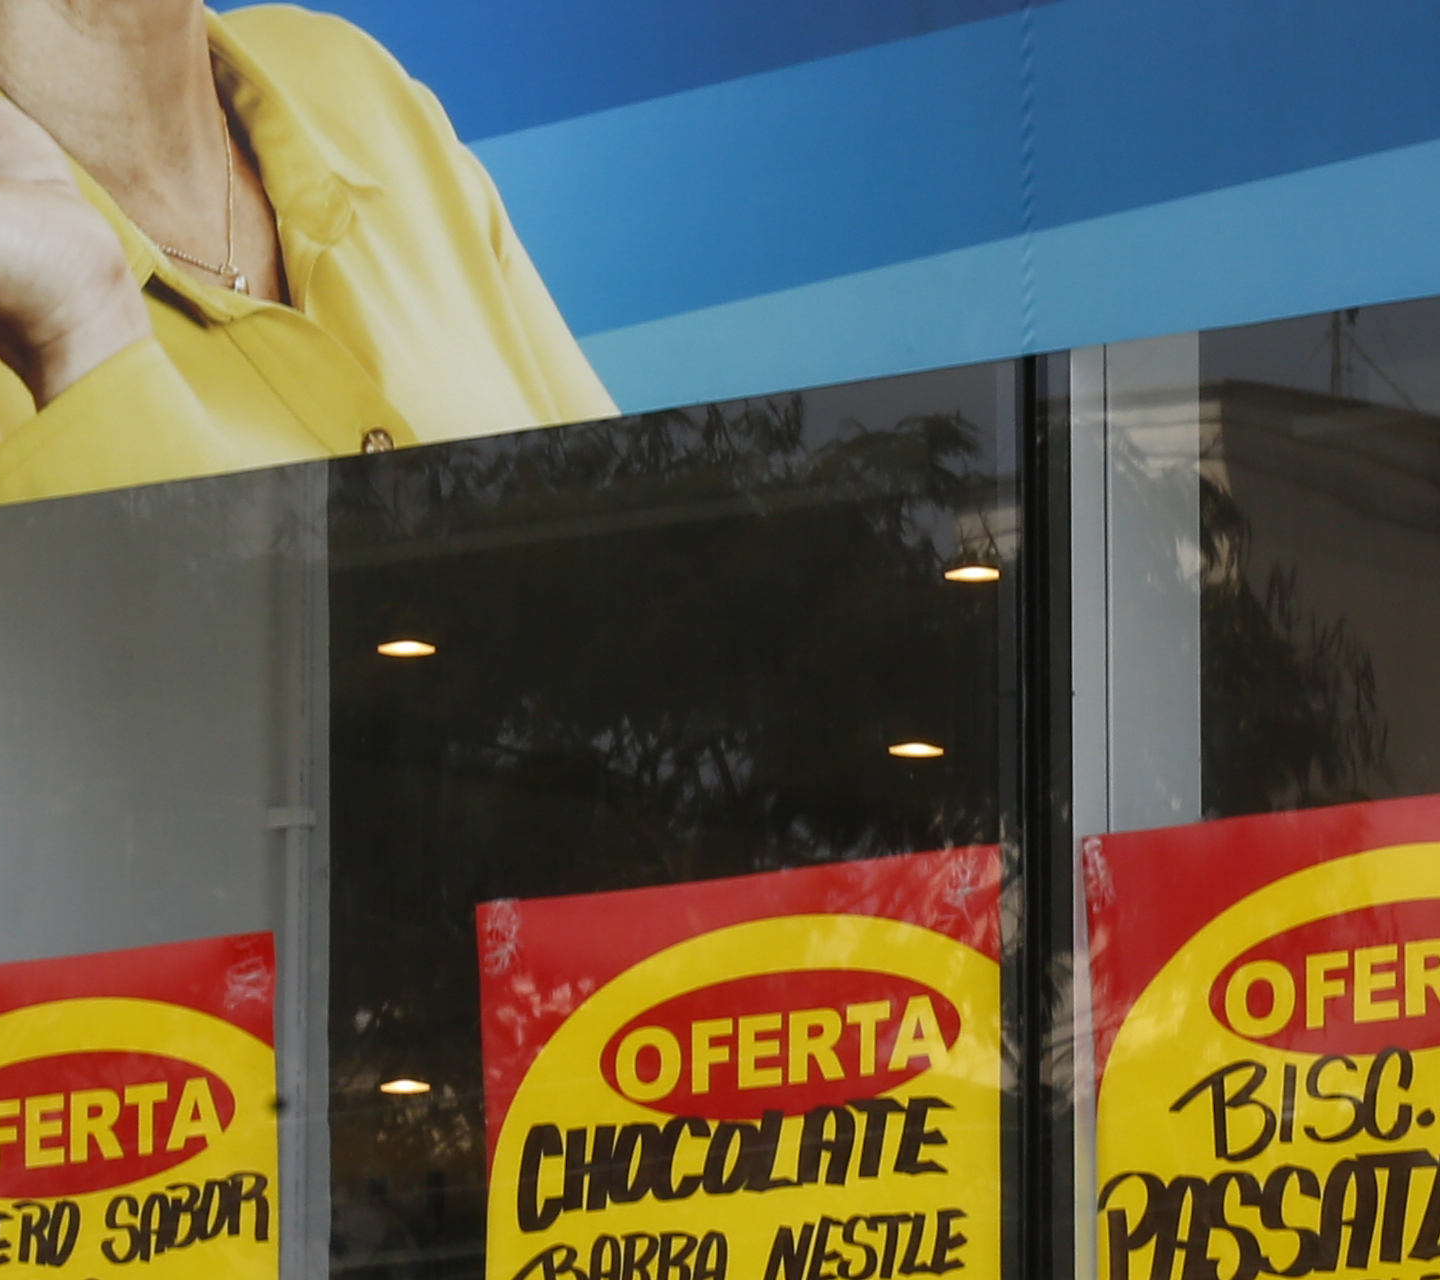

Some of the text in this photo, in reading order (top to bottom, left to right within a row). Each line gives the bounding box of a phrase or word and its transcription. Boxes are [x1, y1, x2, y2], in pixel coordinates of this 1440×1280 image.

[616, 995, 951, 1102] OFERTA
[1171, 1046, 1436, 1164] BISC.
[102, 1172, 269, 1264] SABOR
[516, 1097, 954, 1232] CHOCOLATE
